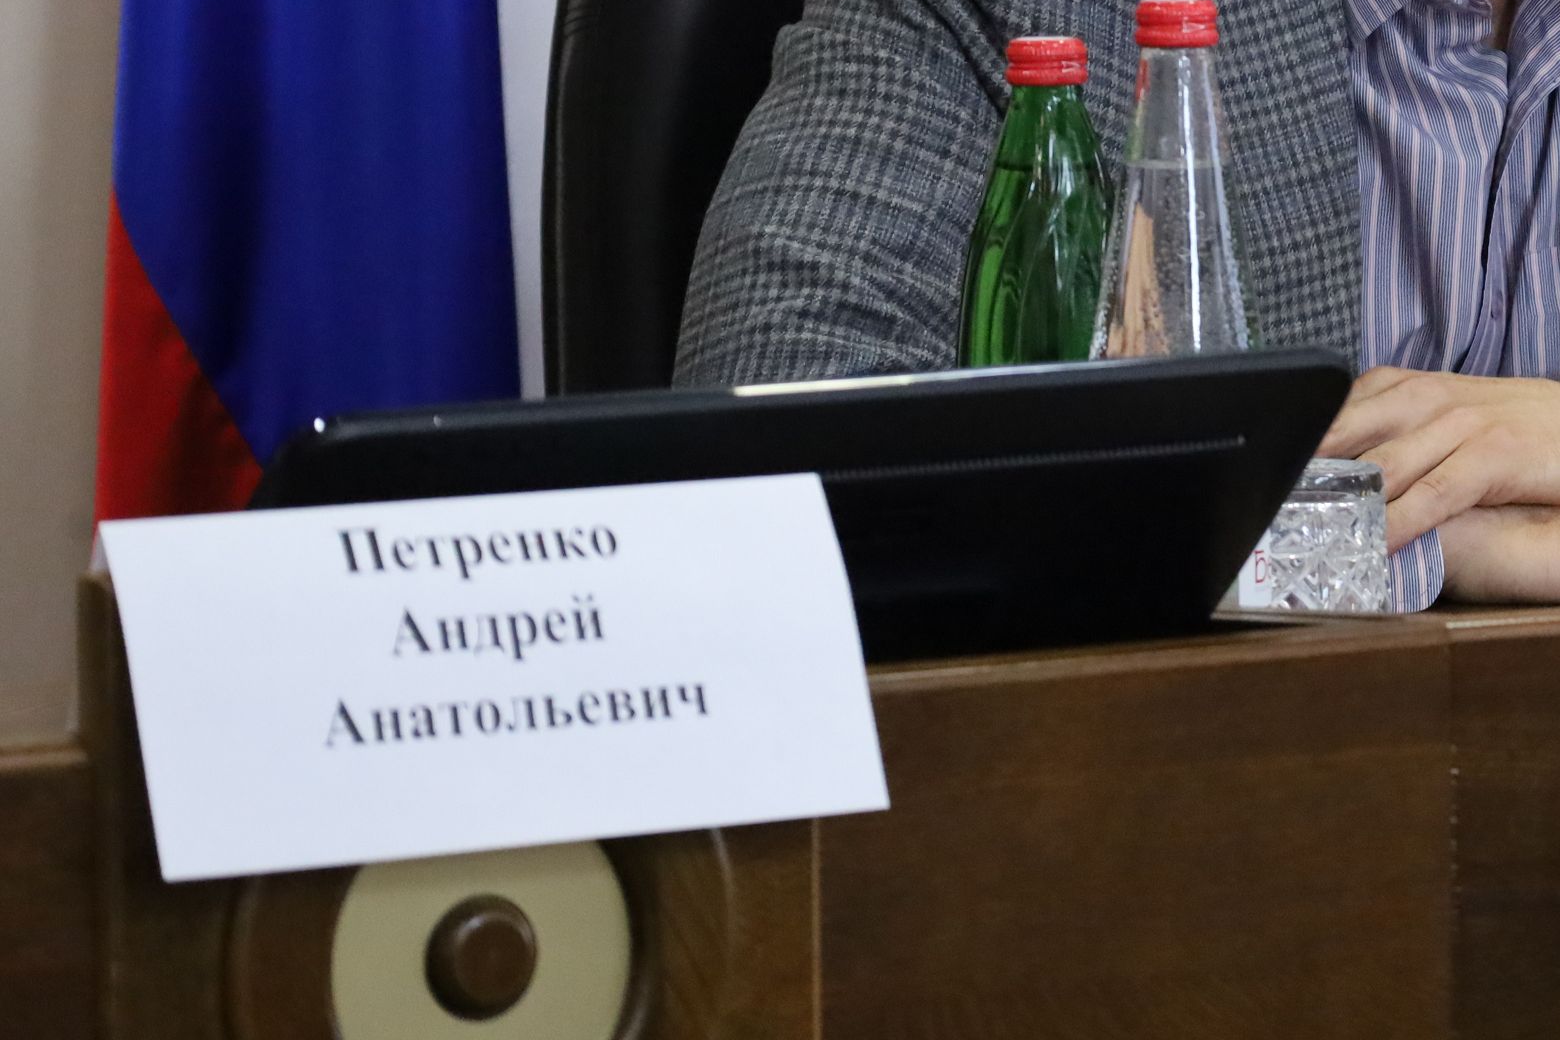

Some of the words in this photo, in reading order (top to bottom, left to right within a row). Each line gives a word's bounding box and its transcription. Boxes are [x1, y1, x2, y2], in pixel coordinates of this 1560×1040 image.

[335, 524, 619, 579] Петренко
[392, 593, 606, 660] Андрей
[324, 683, 711, 747] Анатольевич
